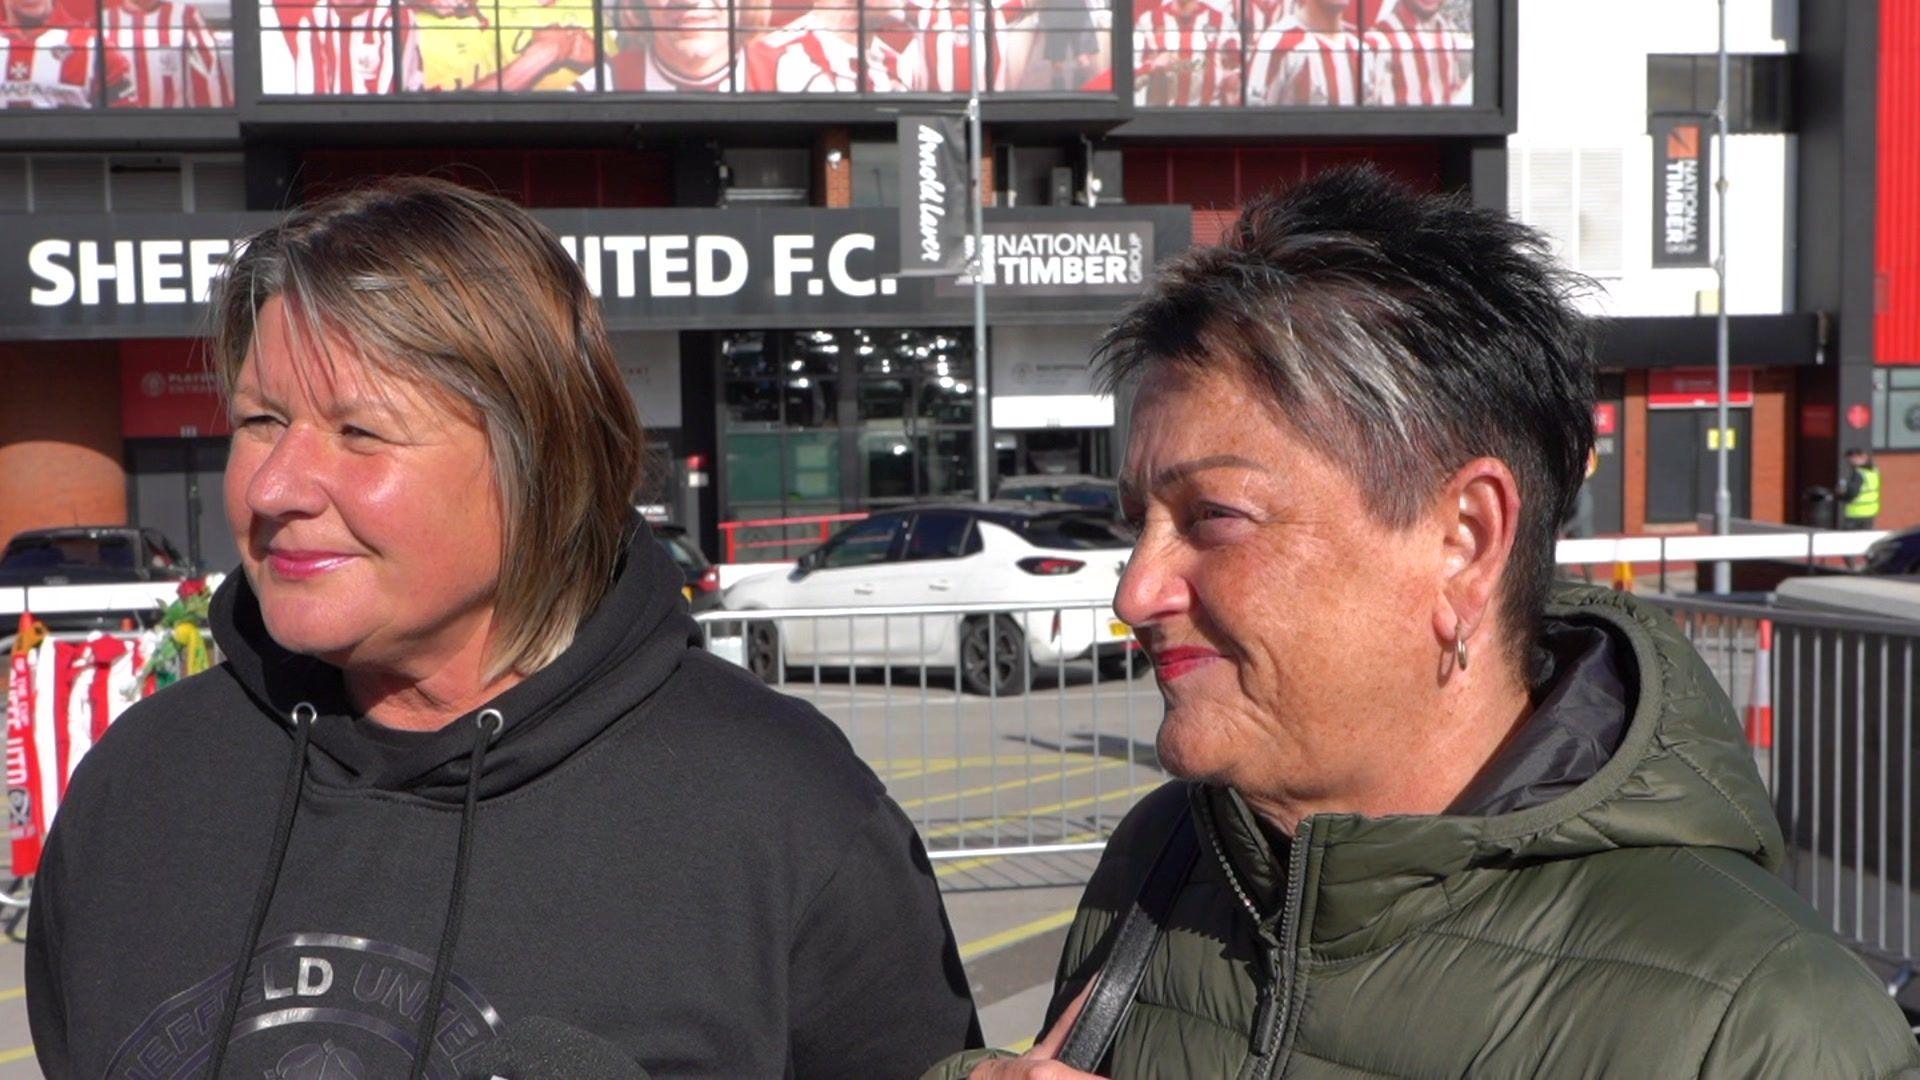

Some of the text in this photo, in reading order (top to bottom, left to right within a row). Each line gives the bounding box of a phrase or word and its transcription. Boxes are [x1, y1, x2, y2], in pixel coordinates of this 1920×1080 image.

[918, 124, 946, 262] Arnold Laver
[1666, 159, 1684, 242] TIMBER
[1684, 159, 1698, 241] NATIONAL
[773, 233, 897, 297] F.C.
[998, 232, 1128, 256] NATIONAL
[998, 256, 1128, 285] TIMBER
[1129, 232, 1143, 284] GROUP
